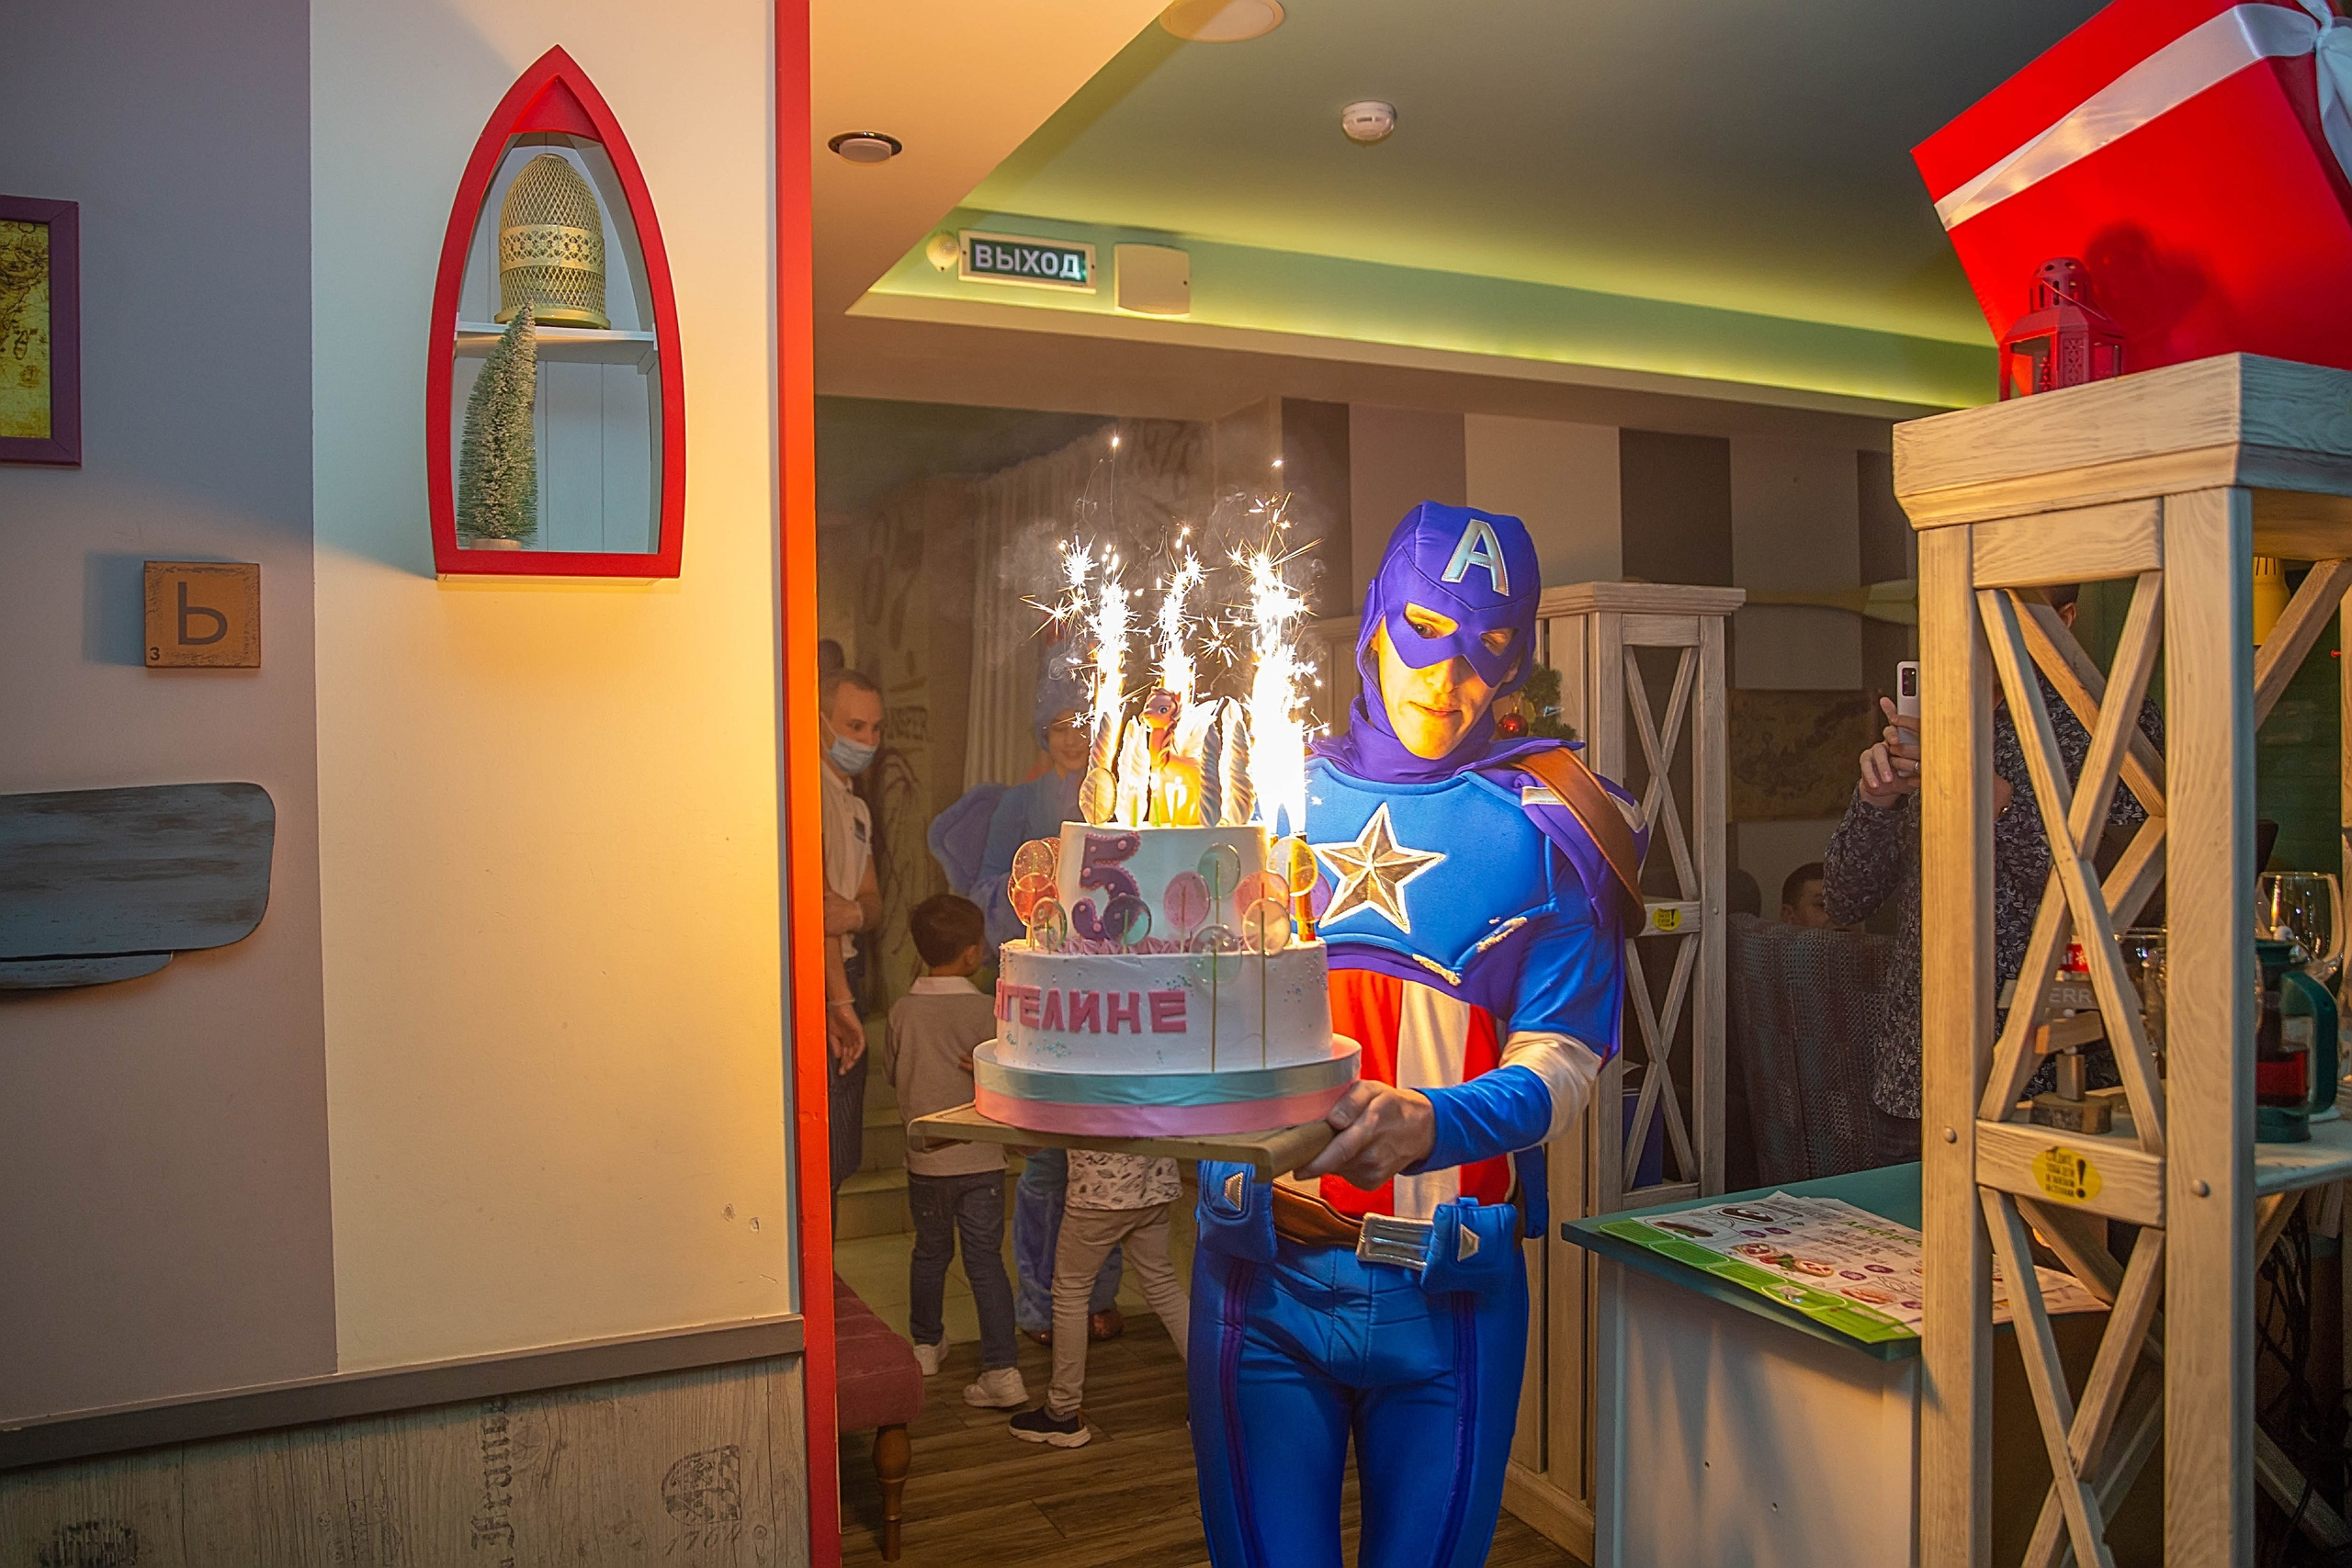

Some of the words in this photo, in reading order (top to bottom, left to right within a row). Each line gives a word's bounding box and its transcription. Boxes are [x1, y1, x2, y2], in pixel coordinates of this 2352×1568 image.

[974, 243, 1080, 280] ВЫХОД
[149, 647, 161, 661] 3
[1071, 831, 1142, 941] 5
